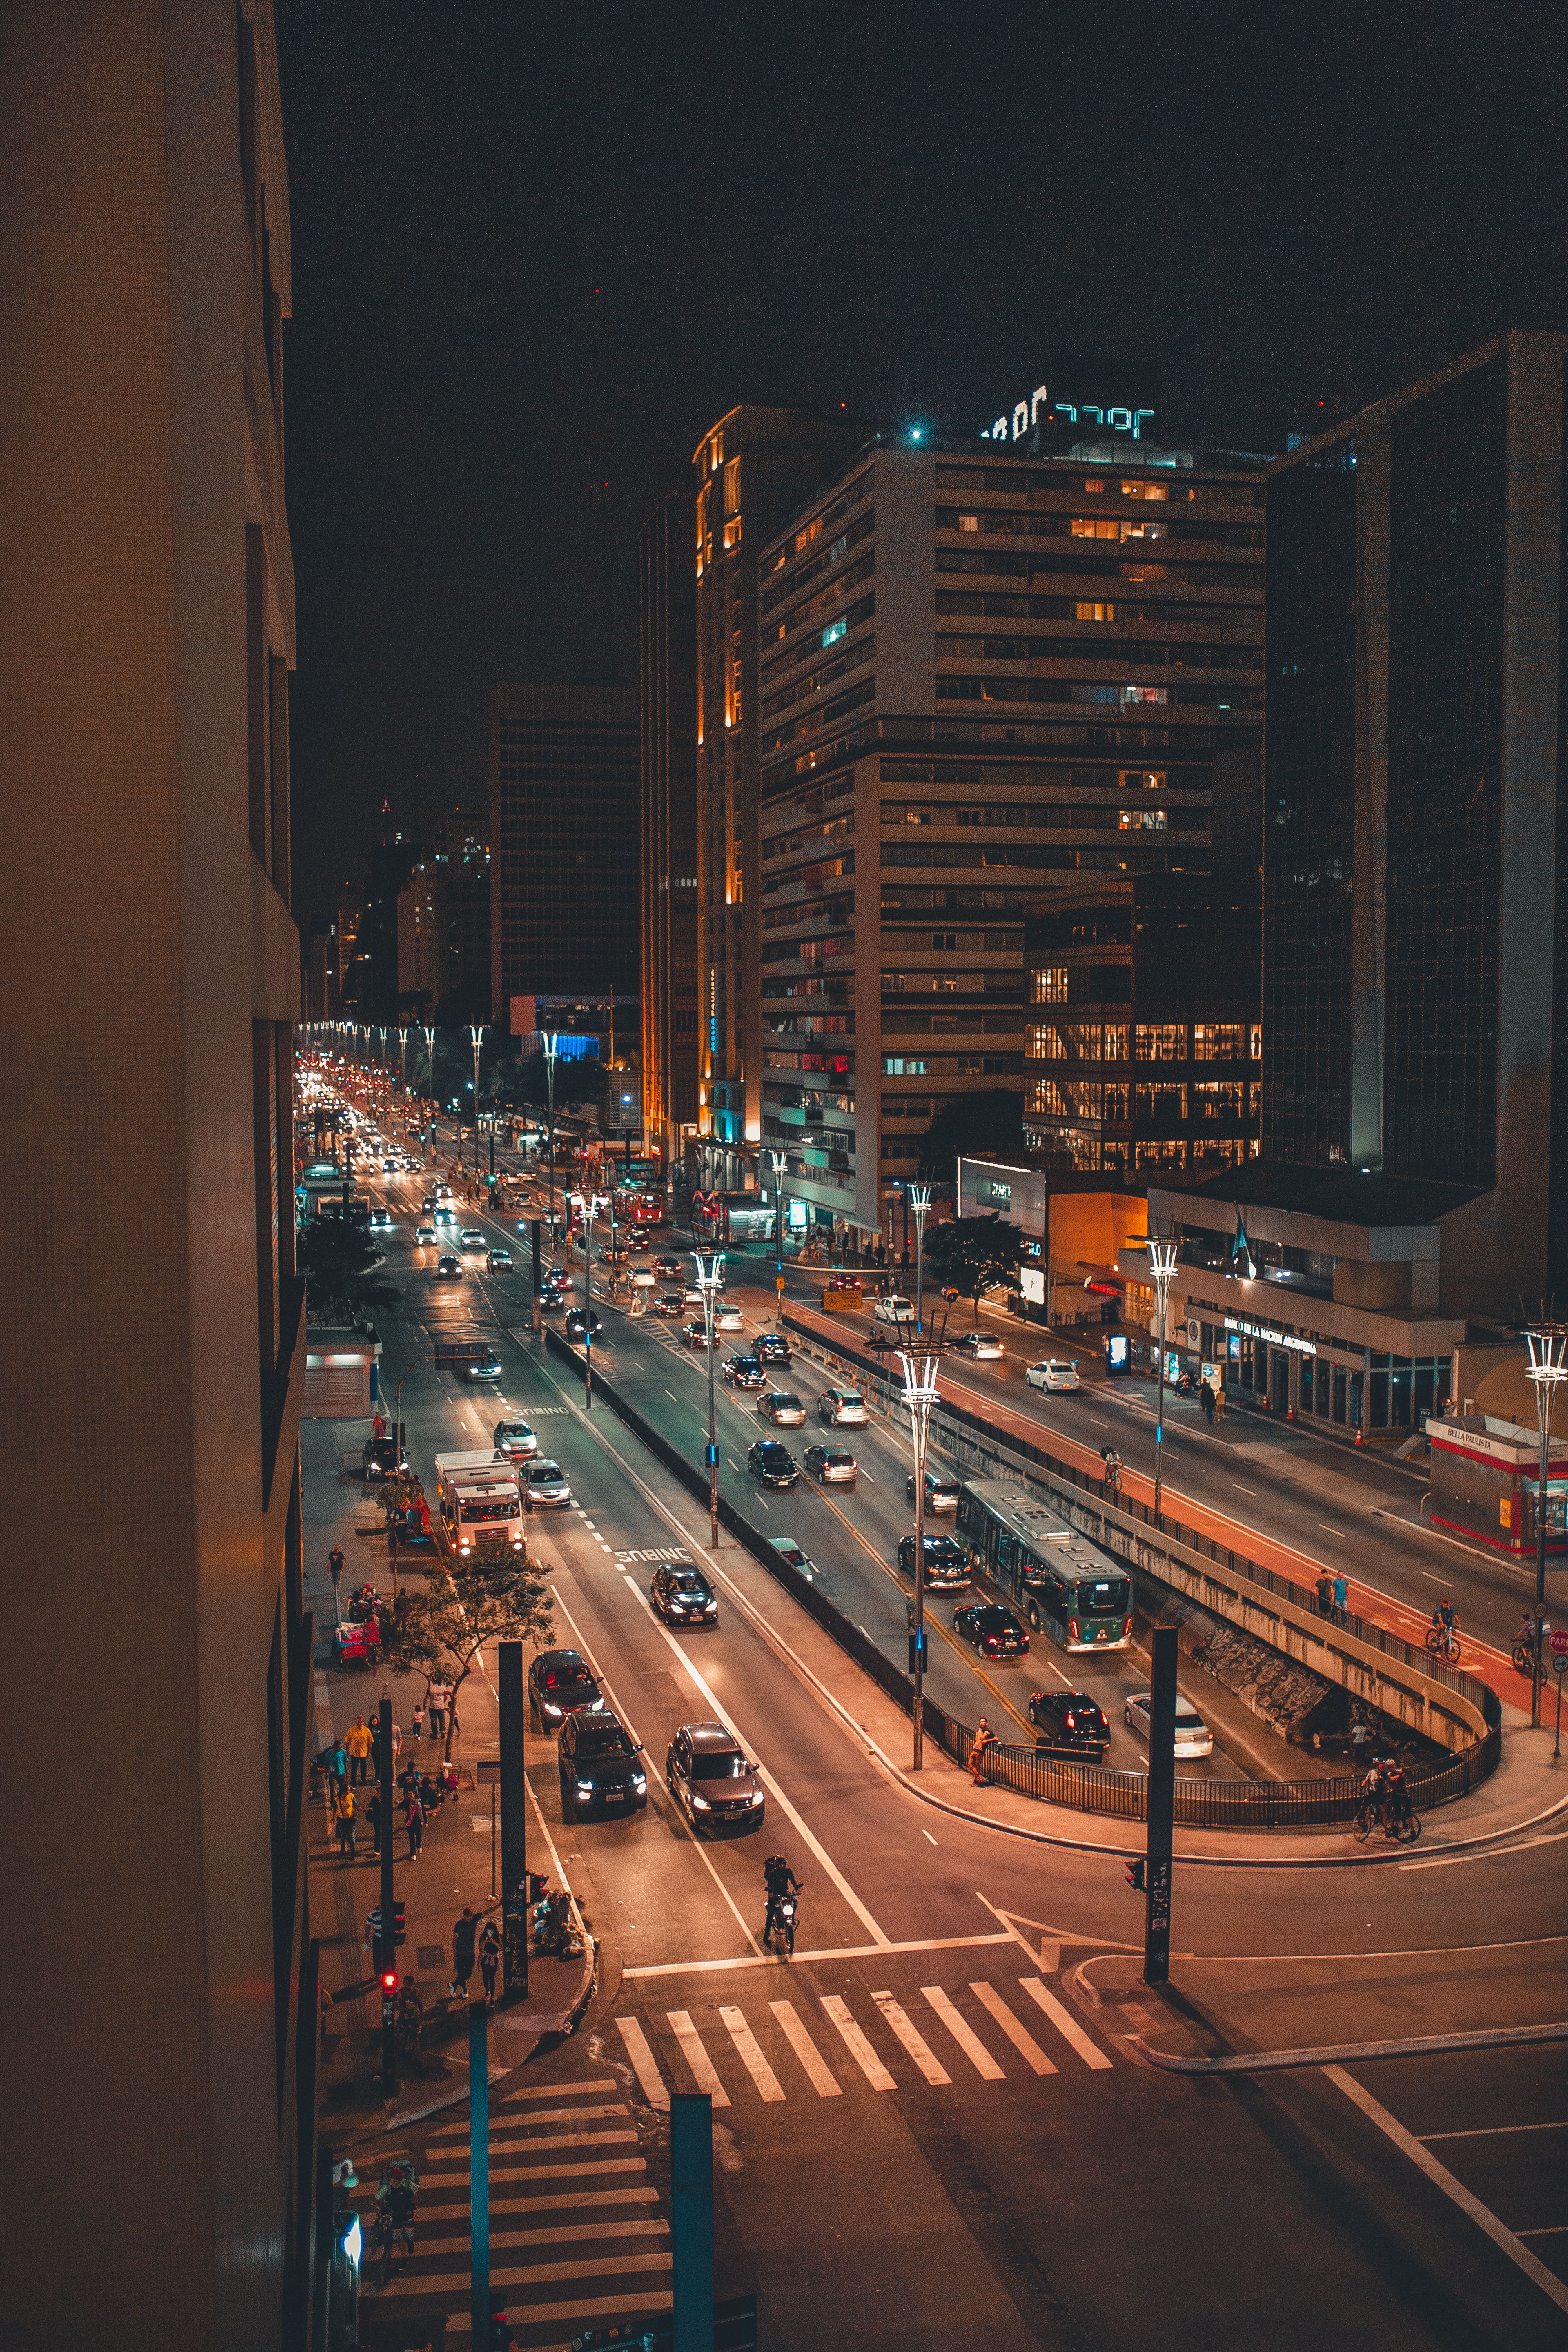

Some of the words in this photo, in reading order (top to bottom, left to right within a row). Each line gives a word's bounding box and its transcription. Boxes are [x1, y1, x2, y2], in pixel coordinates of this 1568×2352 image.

[1252, 1325, 1260, 1337] LA
[1448, 1428, 1464, 1441] BELLA
[1465, 1433, 1491, 1449] PAULISTA
